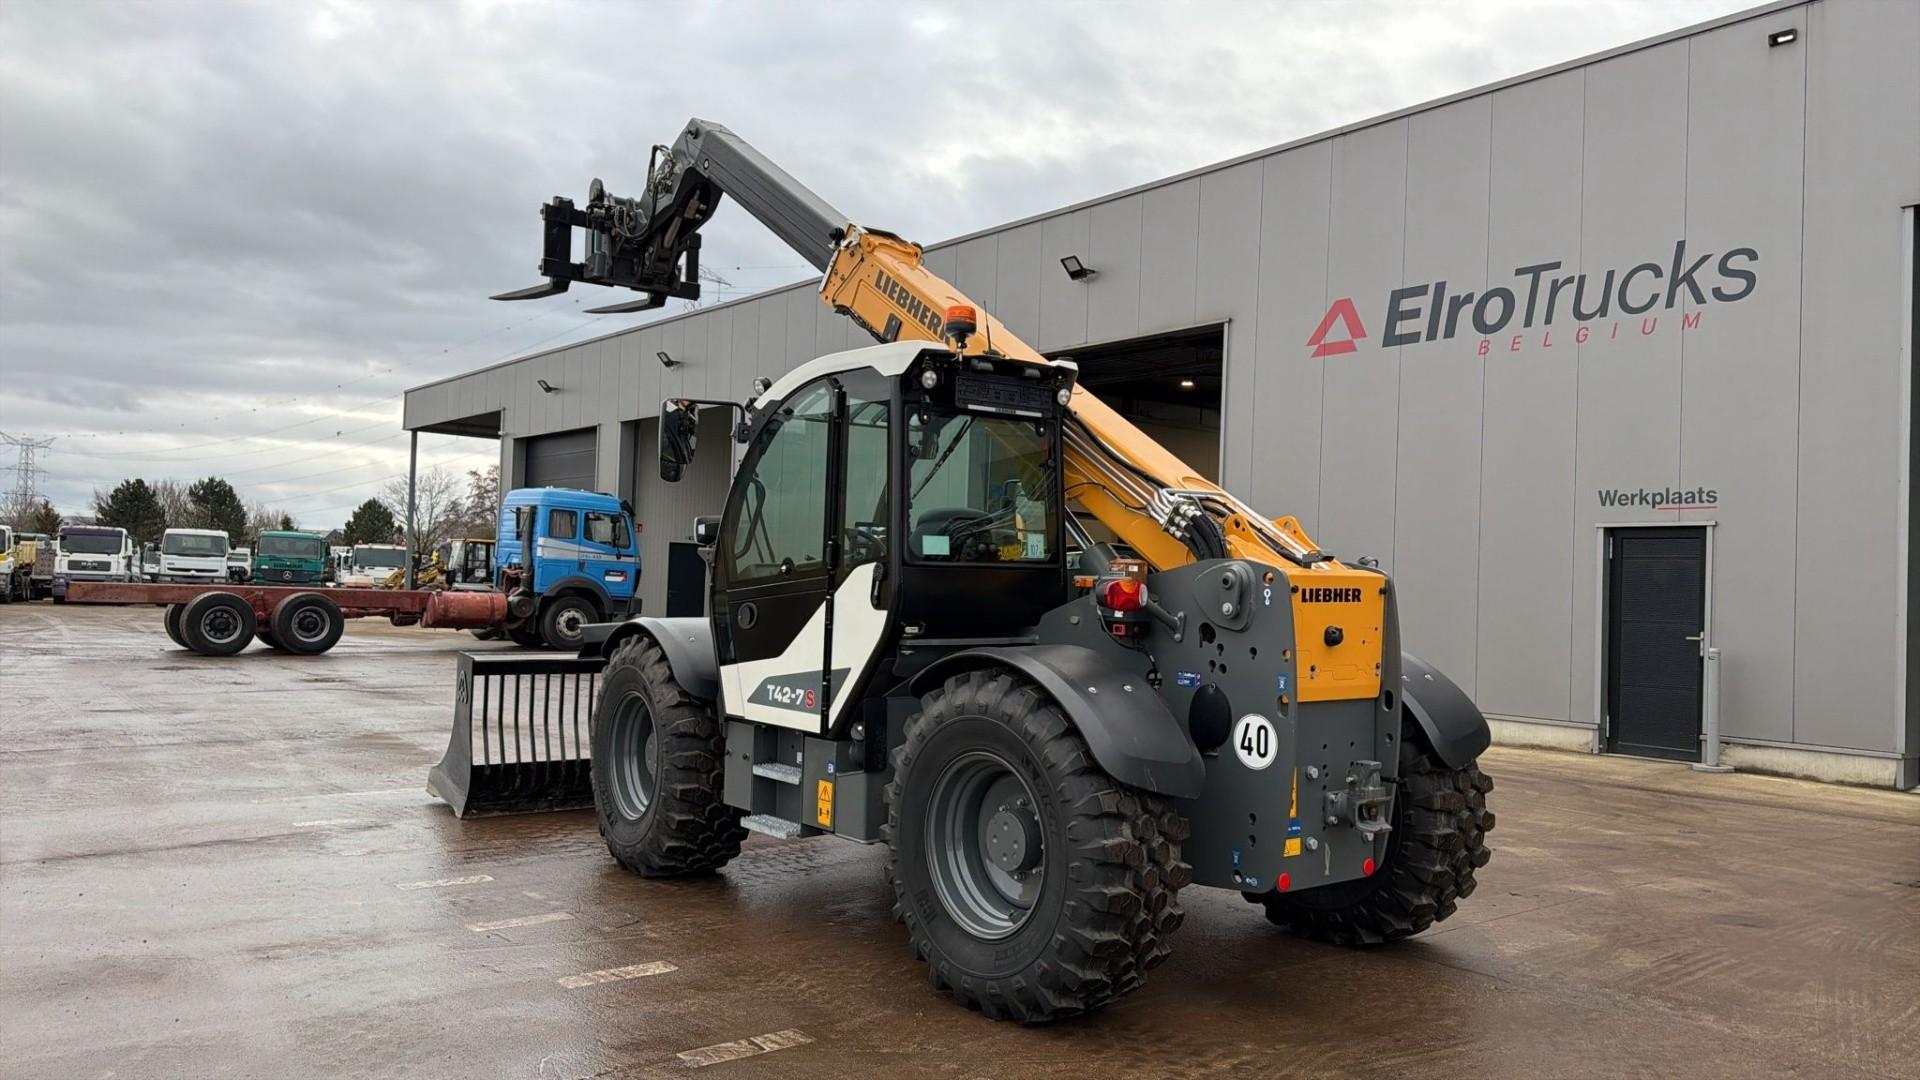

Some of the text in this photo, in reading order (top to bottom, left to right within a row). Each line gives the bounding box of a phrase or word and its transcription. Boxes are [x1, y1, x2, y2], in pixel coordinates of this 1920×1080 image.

[1381, 239, 1760, 348] ElroTrucks
[1477, 311, 1702, 356] BELGIUM
[1598, 487, 1718, 509] Werkplaats
[1301, 588, 1361, 602] LIEBHER
[1240, 722, 1269, 758] 40
